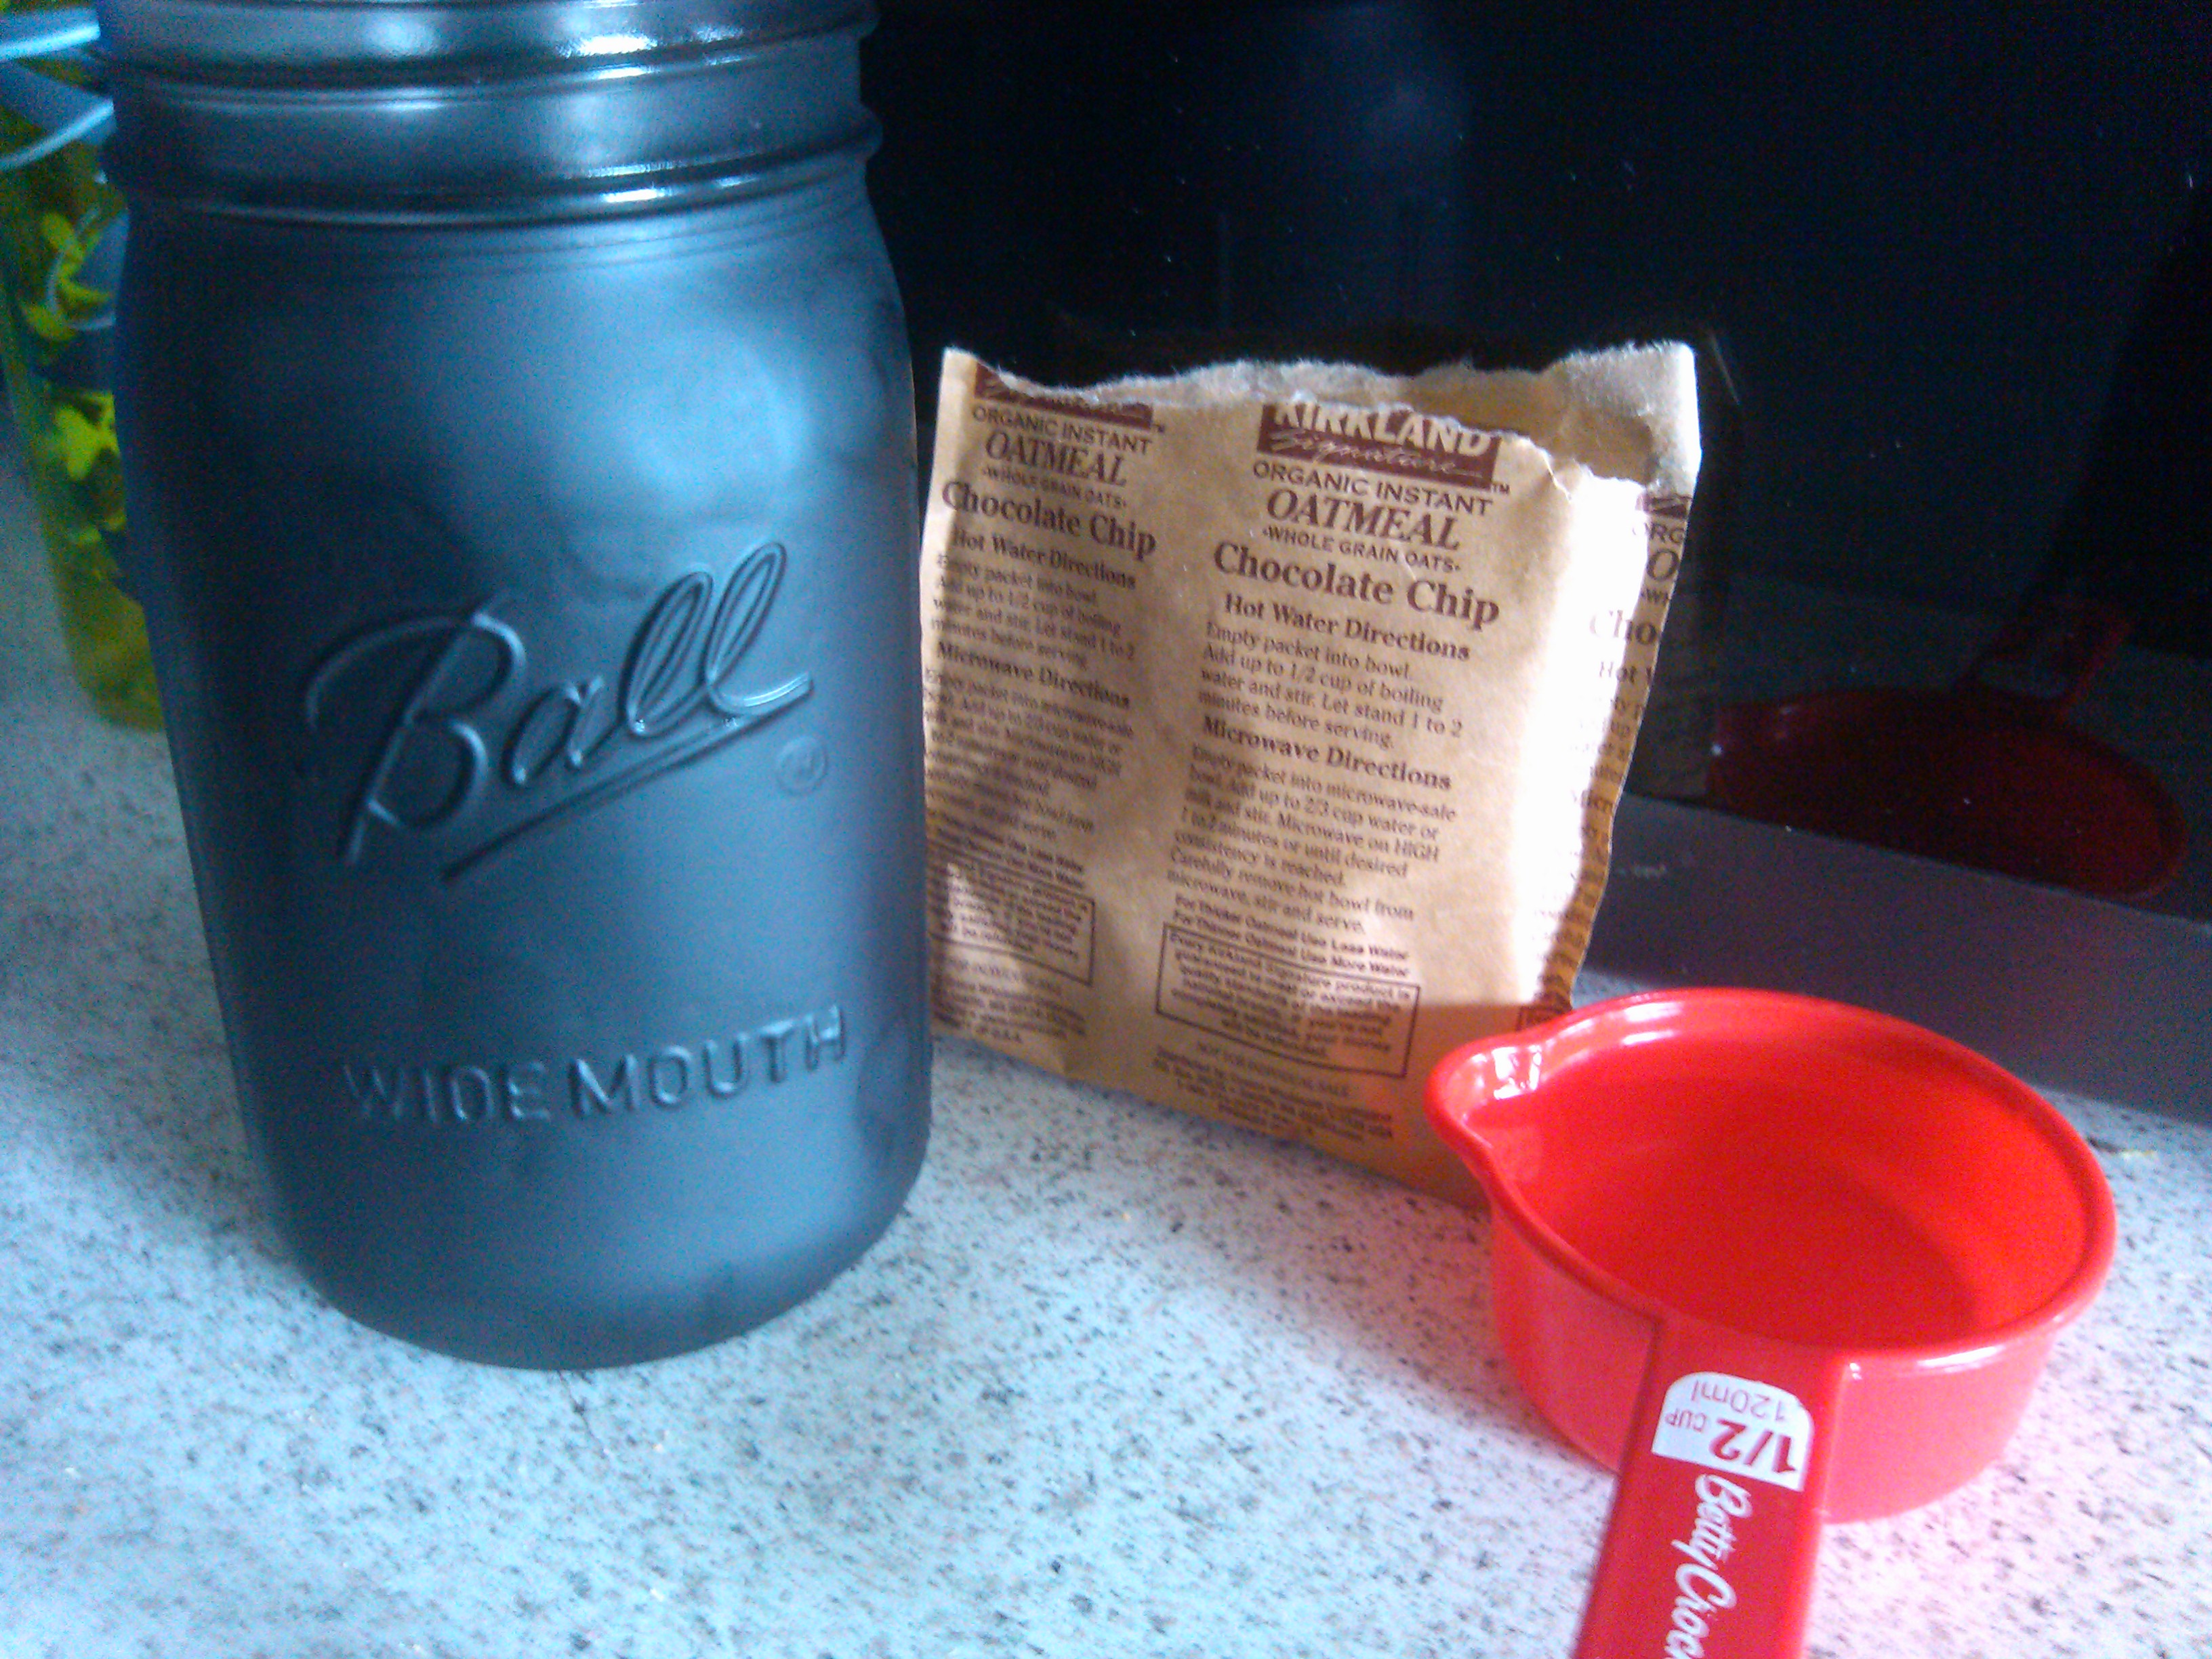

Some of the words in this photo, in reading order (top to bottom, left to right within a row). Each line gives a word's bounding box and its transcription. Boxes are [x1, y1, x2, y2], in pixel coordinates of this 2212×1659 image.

[972, 406, 1057, 436] ORGANIC
[1061, 423, 1153, 456] INSTANT
[985, 429, 1127, 489] OATMEAL
[1271, 403, 1492, 457] KIRKLAND
[1252, 459, 1370, 497] ORGANIC
[1376, 482, 1493, 517] INSTANT
[941, 480, 1080, 537] Chocolate
[1089, 514, 1156, 563] Chip
[1267, 488, 1460, 551] OATMEAL
[1268, 526, 1334, 551] WHOLE
[1338, 541, 1398, 565] GRAIN
[950, 526, 985, 552] Hot
[991, 532, 1046, 561] Water
[1050, 548, 1136, 590] Directions
[1214, 541, 1394, 605] Chocolate
[1407, 579, 1500, 632] Chip
[1205, 621, 1256, 651] Empty
[1263, 636, 1320, 662] packet
[1326, 647, 1360, 670] into
[1224, 592, 1265, 619] Hot
[1273, 602, 1340, 635] Water
[1343, 617, 1471, 661] Directions
[938, 640, 1034, 682] Microwave
[1039, 666, 1130, 709] Directions
[1204, 643, 1235, 666] Add
[1240, 655, 1262, 676] up
[1266, 656, 1284, 678] to
[1290, 661, 1315, 685] 1/2
[1319, 672, 1352, 694] cup
[1357, 679, 1376, 697] of
[1380, 682, 1443, 714] boiling
[303, 541, 814, 867] Ball
[1197, 690, 1261, 718] minutes
[1265, 702, 1320, 731] before
[1202, 670, 1246, 692] water
[1248, 678, 1281, 700] and
[1322, 693, 1349, 715] Let
[1355, 703, 1405, 727] stand
[1412, 710, 1419, 729] 1
[1426, 716, 1446, 736] to
[1451, 718, 1463, 738] 2
[1203, 714, 1322, 764] Microwave
[1326, 745, 1452, 792] Directions
[1235, 760, 1287, 786] packet
[1290, 773, 1322, 794] into
[1259, 788, 1279, 808] up
[1284, 792, 1302, 811] to
[1304, 796, 1330, 815] 2/3
[1332, 806, 1364, 827] cup
[1368, 815, 1417, 837] water
[1420, 825, 1440, 841] or
[1277, 811, 1364, 850] Microwave
[1367, 838, 1389, 854] on
[1393, 838, 1439, 863] HIGH
[1218, 817, 1280, 849] minutes
[1284, 838, 1302, 853] or
[1304, 841, 1342, 866] until
[1343, 849, 1409, 879] desired
[1265, 854, 1277, 869] is
[1170, 845, 1233, 880] Carefully
[1238, 869, 1295, 893] remove
[1298, 881, 1325, 904] hot
[1330, 890, 1370, 912] bowl
[1374, 897, 1415, 922] from
[1282, 903, 1313, 923] and
[1300, 930, 1327, 949] Use
[1331, 937, 1365, 955] Less
[1368, 943, 1410, 961] Water
[1300, 947, 1327, 965] Use
[1331, 954, 1367, 971] More
[1368, 960, 1410, 978] Water
[341, 1059, 552, 1125] WIDE
[567, 1004, 848, 1120] MOUTH
[1664, 1406, 1708, 1433] CUP
[1689, 1378, 1787, 1423] 120ml
[1708, 1416, 1798, 1474] 1/2
[1671, 1473, 1753, 1571] Betty
